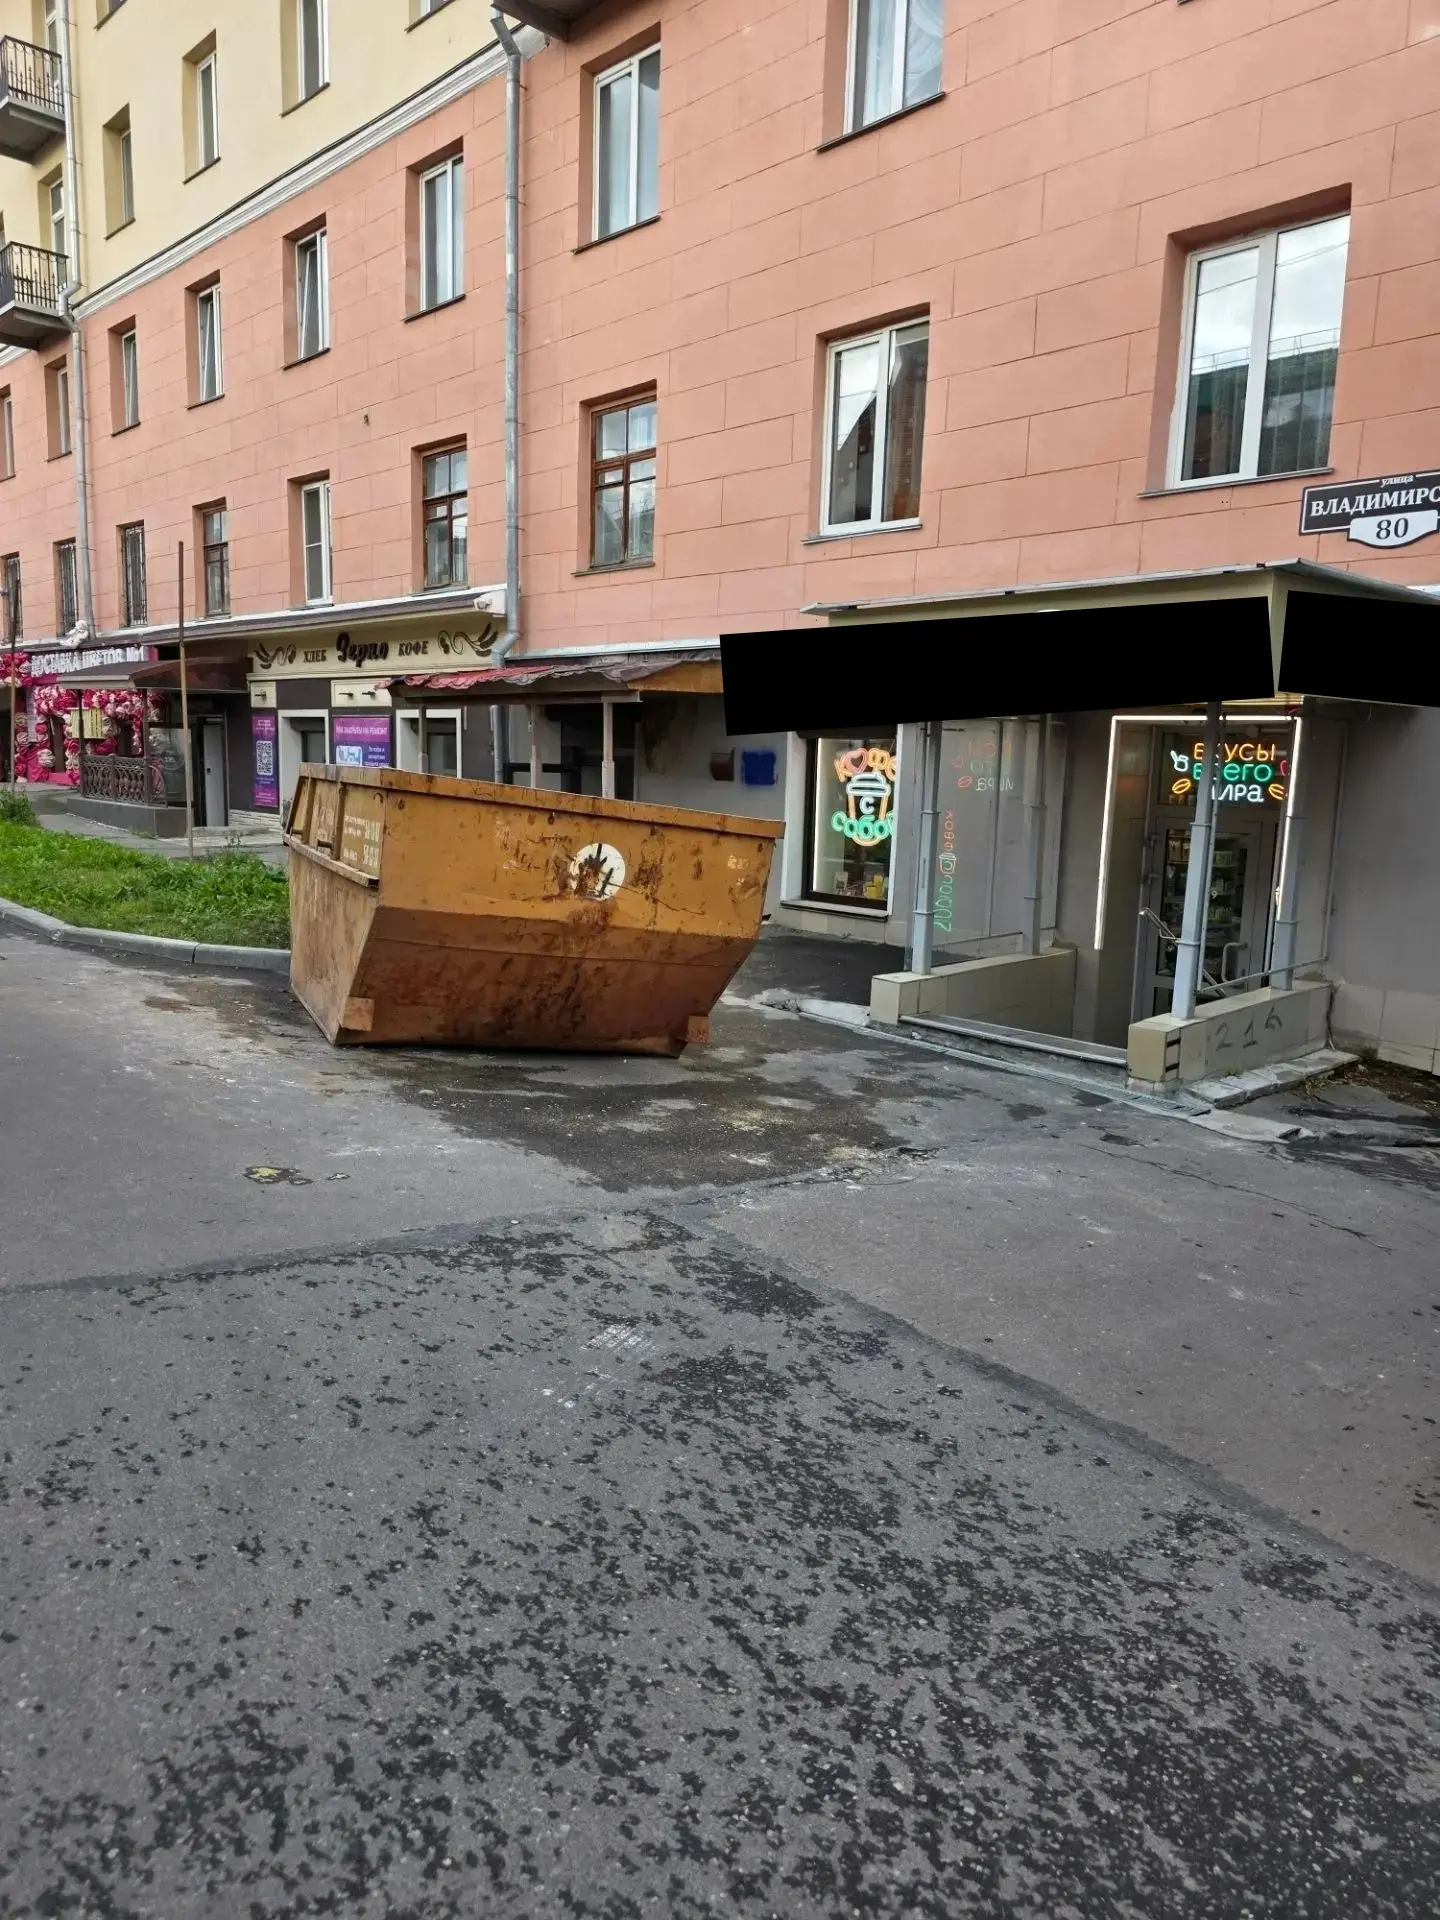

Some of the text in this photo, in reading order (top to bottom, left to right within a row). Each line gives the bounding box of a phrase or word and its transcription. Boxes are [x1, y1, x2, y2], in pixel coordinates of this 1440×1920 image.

[1381, 475, 1413, 488] улица
[1376, 518, 1409, 540] 80
[303, 632, 429, 668] ХЛЕБ Зерно КОФЕ
